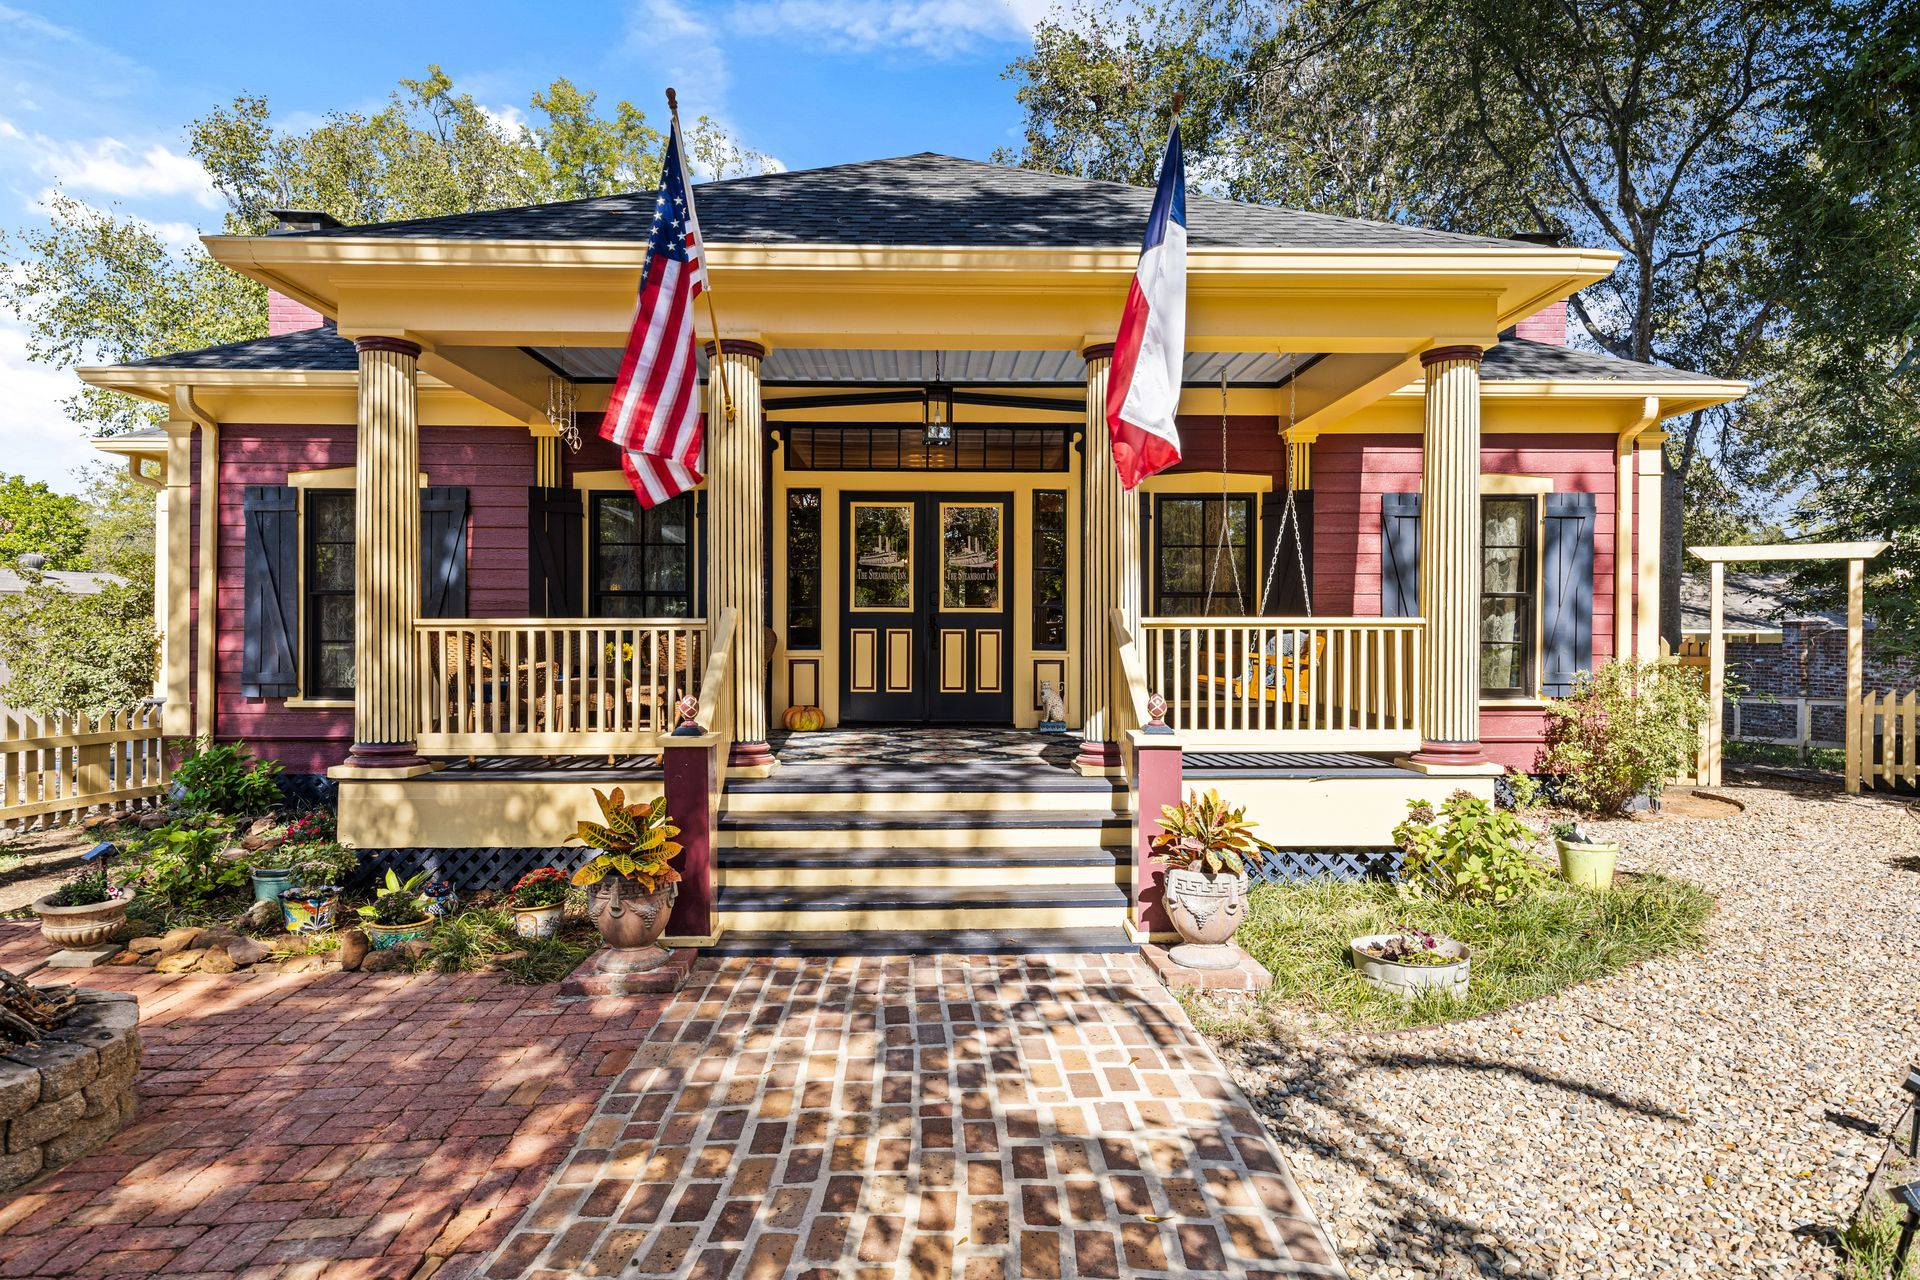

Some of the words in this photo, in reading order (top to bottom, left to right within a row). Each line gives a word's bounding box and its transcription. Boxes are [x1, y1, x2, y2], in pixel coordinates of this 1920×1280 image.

[858, 569, 867, 580] THE
[869, 569, 897, 580] STEAMBOAT
[897, 569, 906, 580] INN
[947, 569, 957, 580] THE
[958, 569, 986, 580] STEAMBOAT
[987, 569, 996, 580] INN
